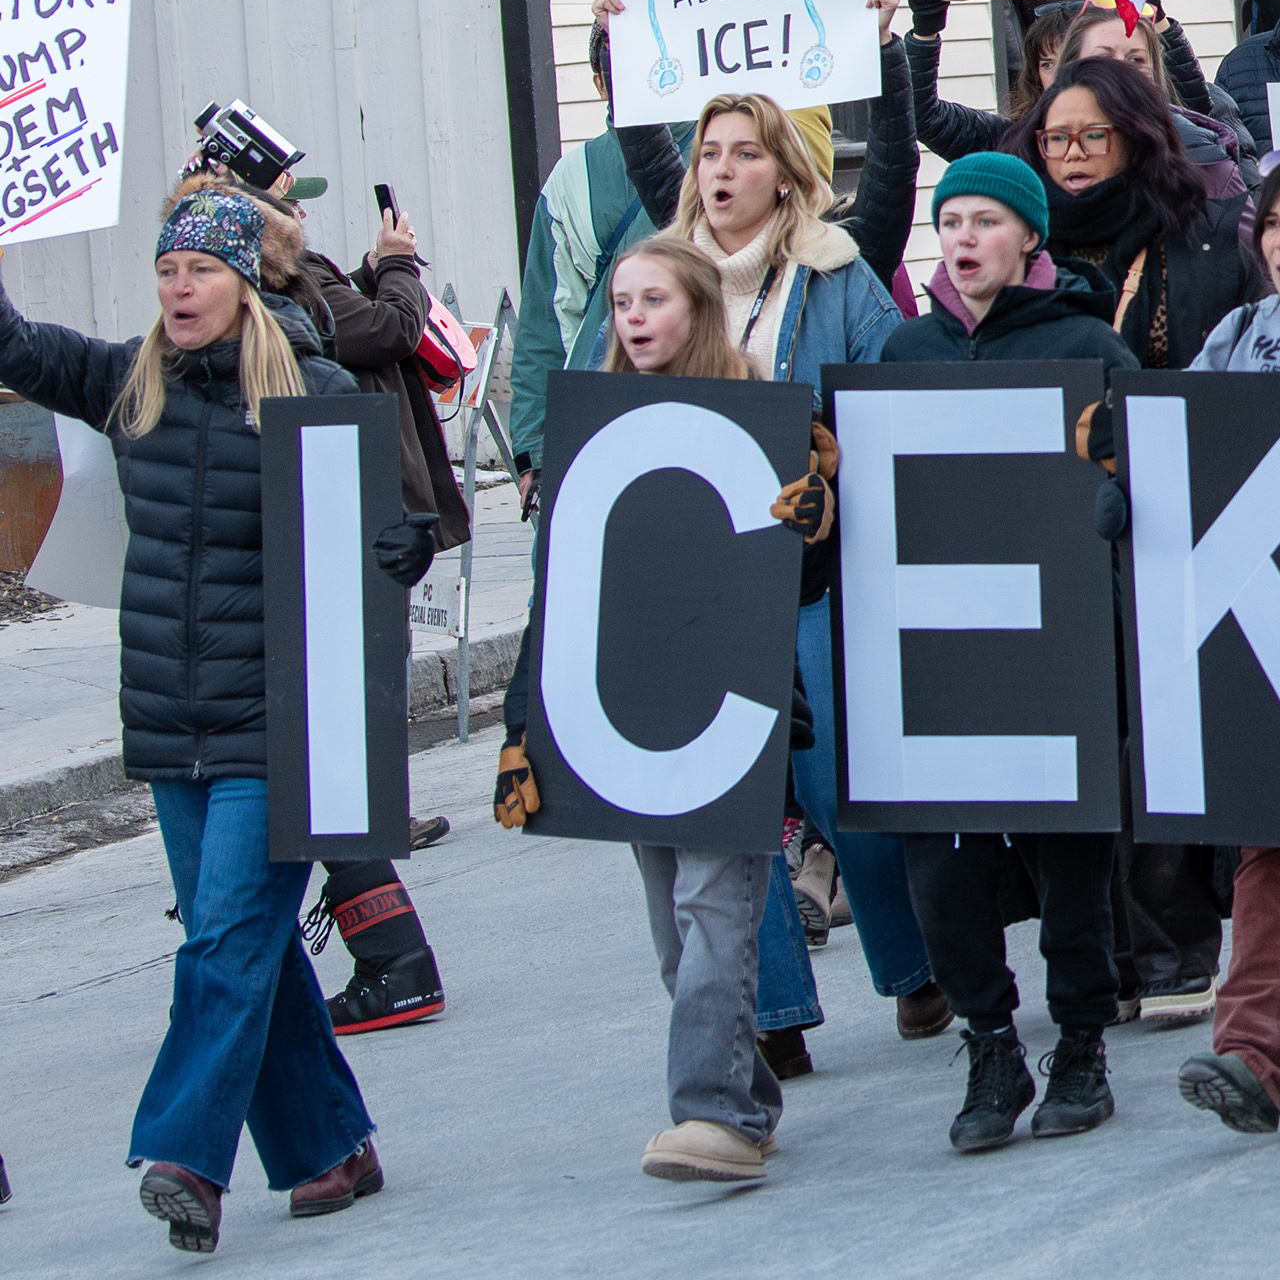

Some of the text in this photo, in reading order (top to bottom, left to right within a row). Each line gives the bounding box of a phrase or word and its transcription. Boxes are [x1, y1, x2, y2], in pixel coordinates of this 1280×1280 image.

[0, 27, 87, 92] UMP.
[696, 13, 792, 78] ICE!
[0, 121, 120, 226] GSETH
[409, 604, 448, 628] ECIAL EVENTS
[422, 582, 434, 602] PC
